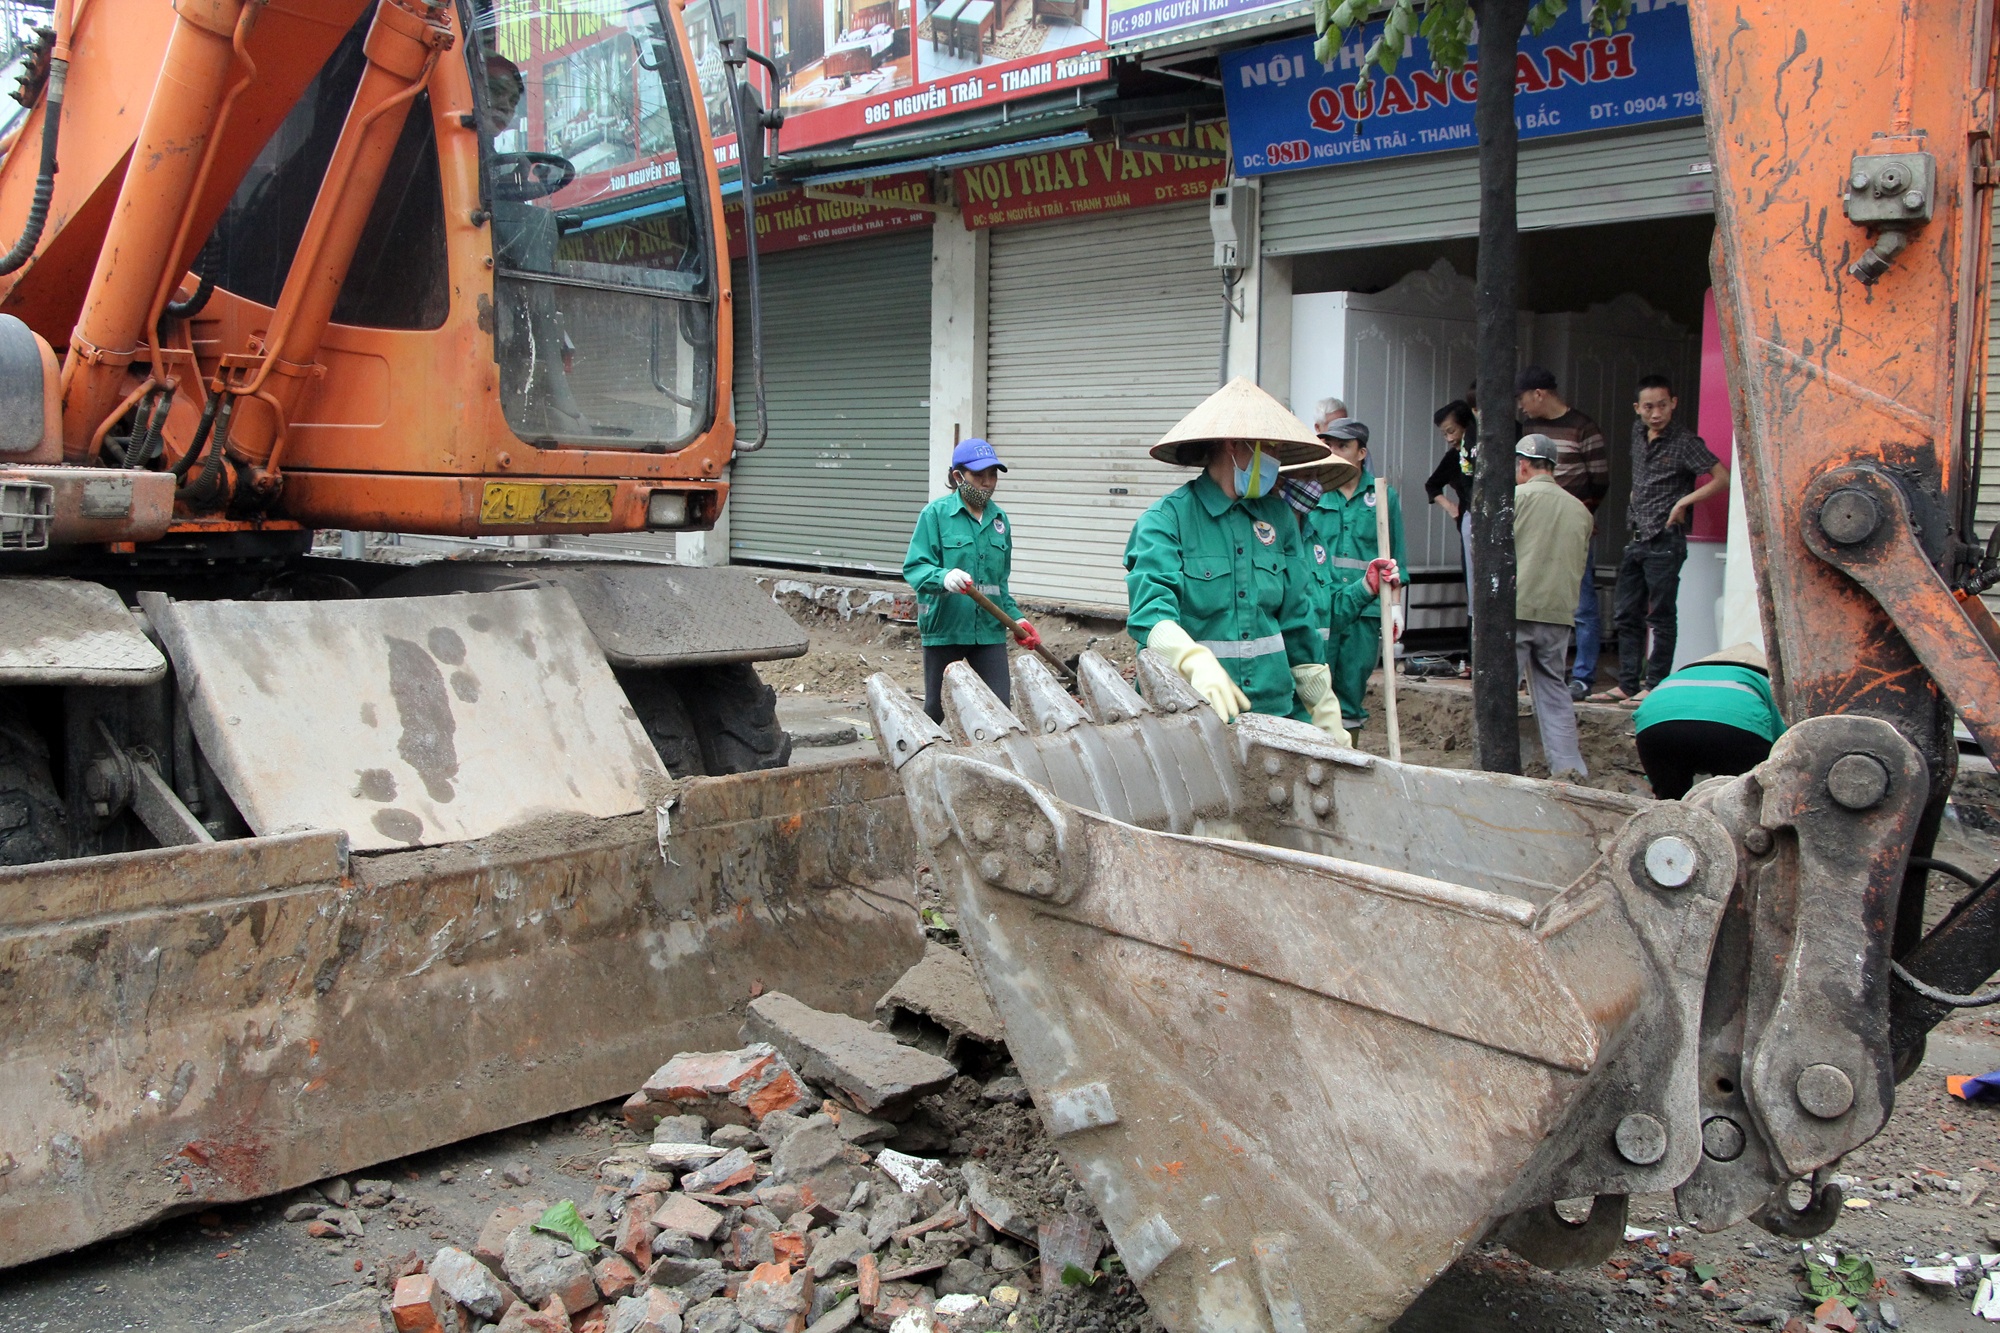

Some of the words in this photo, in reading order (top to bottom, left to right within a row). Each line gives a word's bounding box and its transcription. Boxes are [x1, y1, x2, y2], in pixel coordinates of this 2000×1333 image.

[1111, 17, 1129, 36] ĐC:
[1131, 10, 1152, 30] 98D
[1240, 53, 1305, 88] NỘI
[1308, 60, 1478, 133] QUANG
[1514, 33, 1637, 95] ANH
[864, 103, 890, 125] 98C
[894, 83, 947, 118] NGUYỄN
[950, 77, 983, 105] TRÃI
[1000, 61, 1051, 93] THANH
[1590, 103, 1619, 120] ĐT:
[1623, 96, 1668, 115] 0904
[1243, 152, 1265, 168] ĐC:
[1266, 140, 1311, 166] 98D
[1374, 130, 1407, 150] TRÃI
[1418, 123, 1471, 144] THANH
[1526, 103, 1561, 128] BẮC
[1014, 147, 1089, 196] THAT
[1181, 181, 1207, 196] 355
[773, 200, 812, 231] THẤT
[988, 211, 1005, 224] 98C
[1070, 197, 1101, 212] THANH
[1104, 190, 1131, 208] XUÂN
[812, 228, 830, 240] 100
[891, 216, 902, 226] TX
[910, 213, 923, 222] HN
